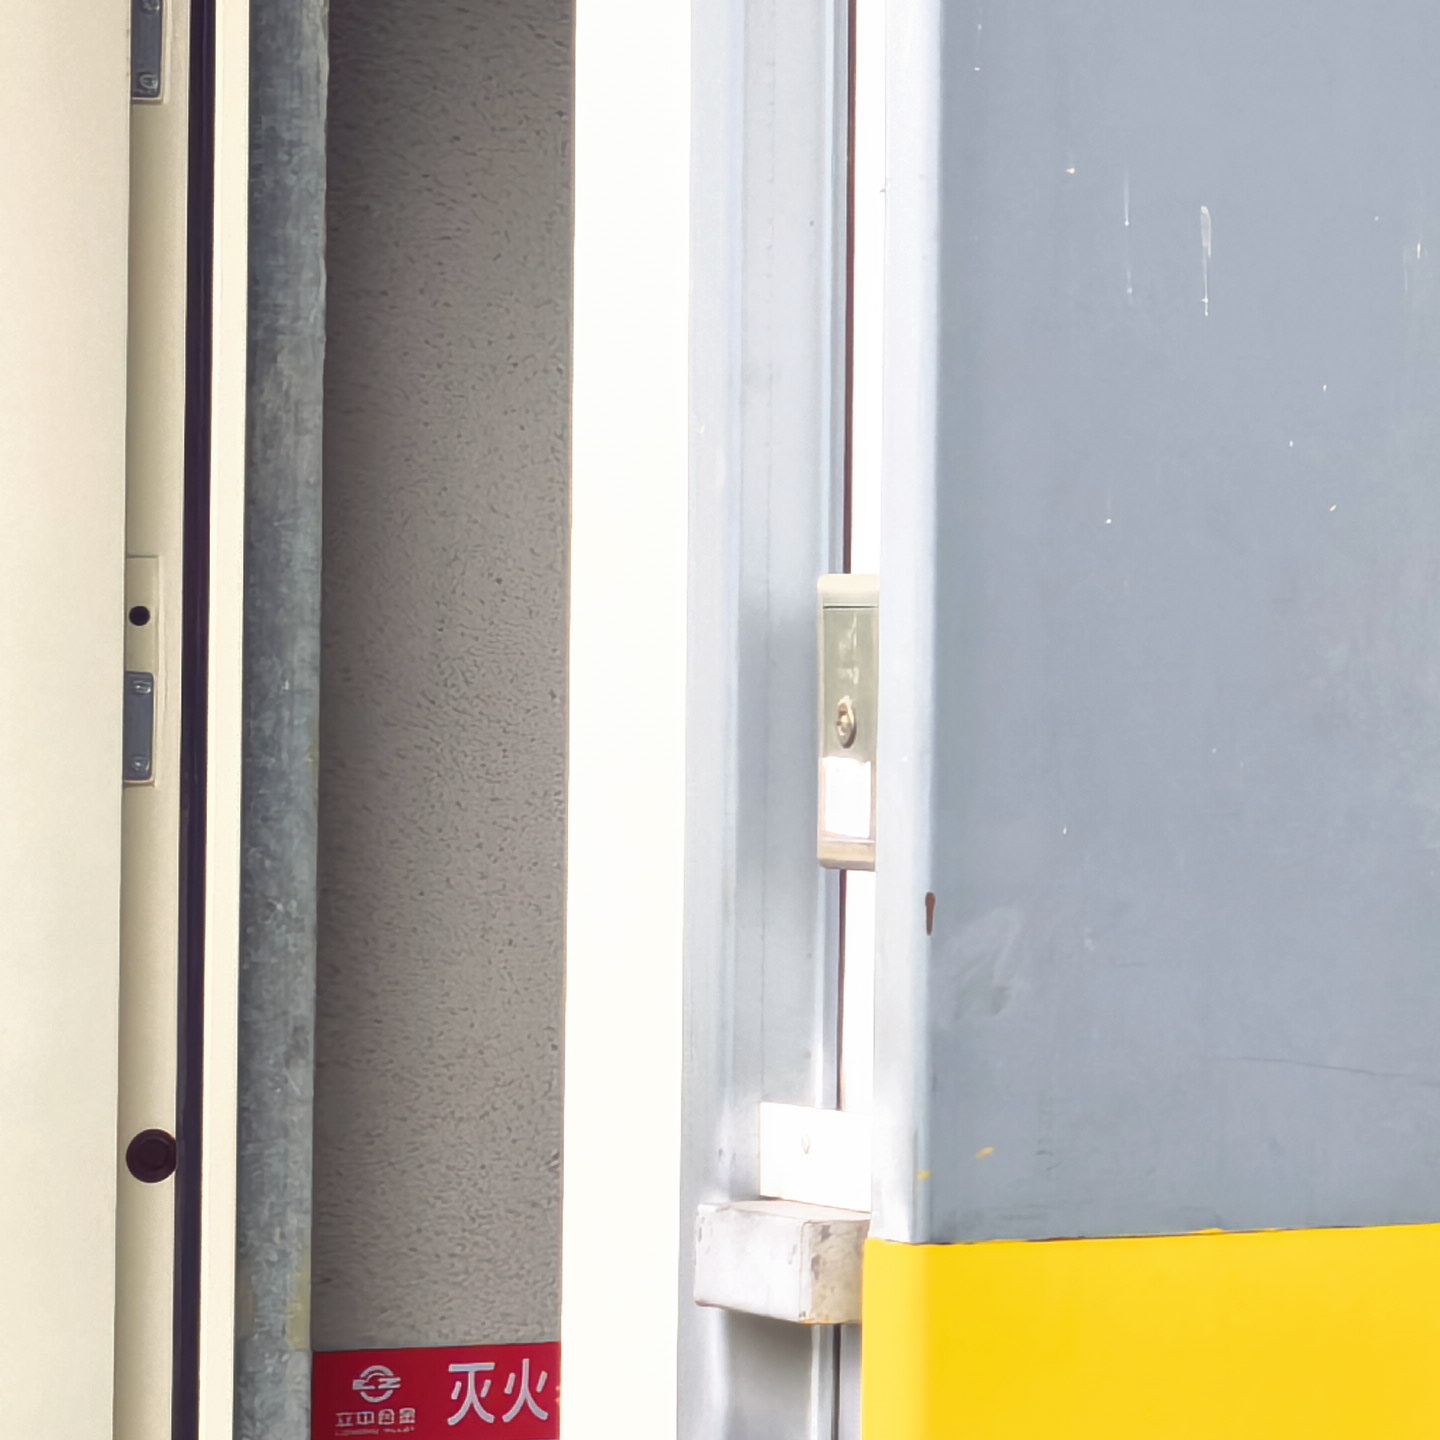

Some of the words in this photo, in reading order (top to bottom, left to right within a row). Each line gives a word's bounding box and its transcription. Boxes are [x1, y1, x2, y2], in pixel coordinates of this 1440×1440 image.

[447, 1358, 561, 1427] 灭火
[335, 1408, 416, 1428] 立中合金
